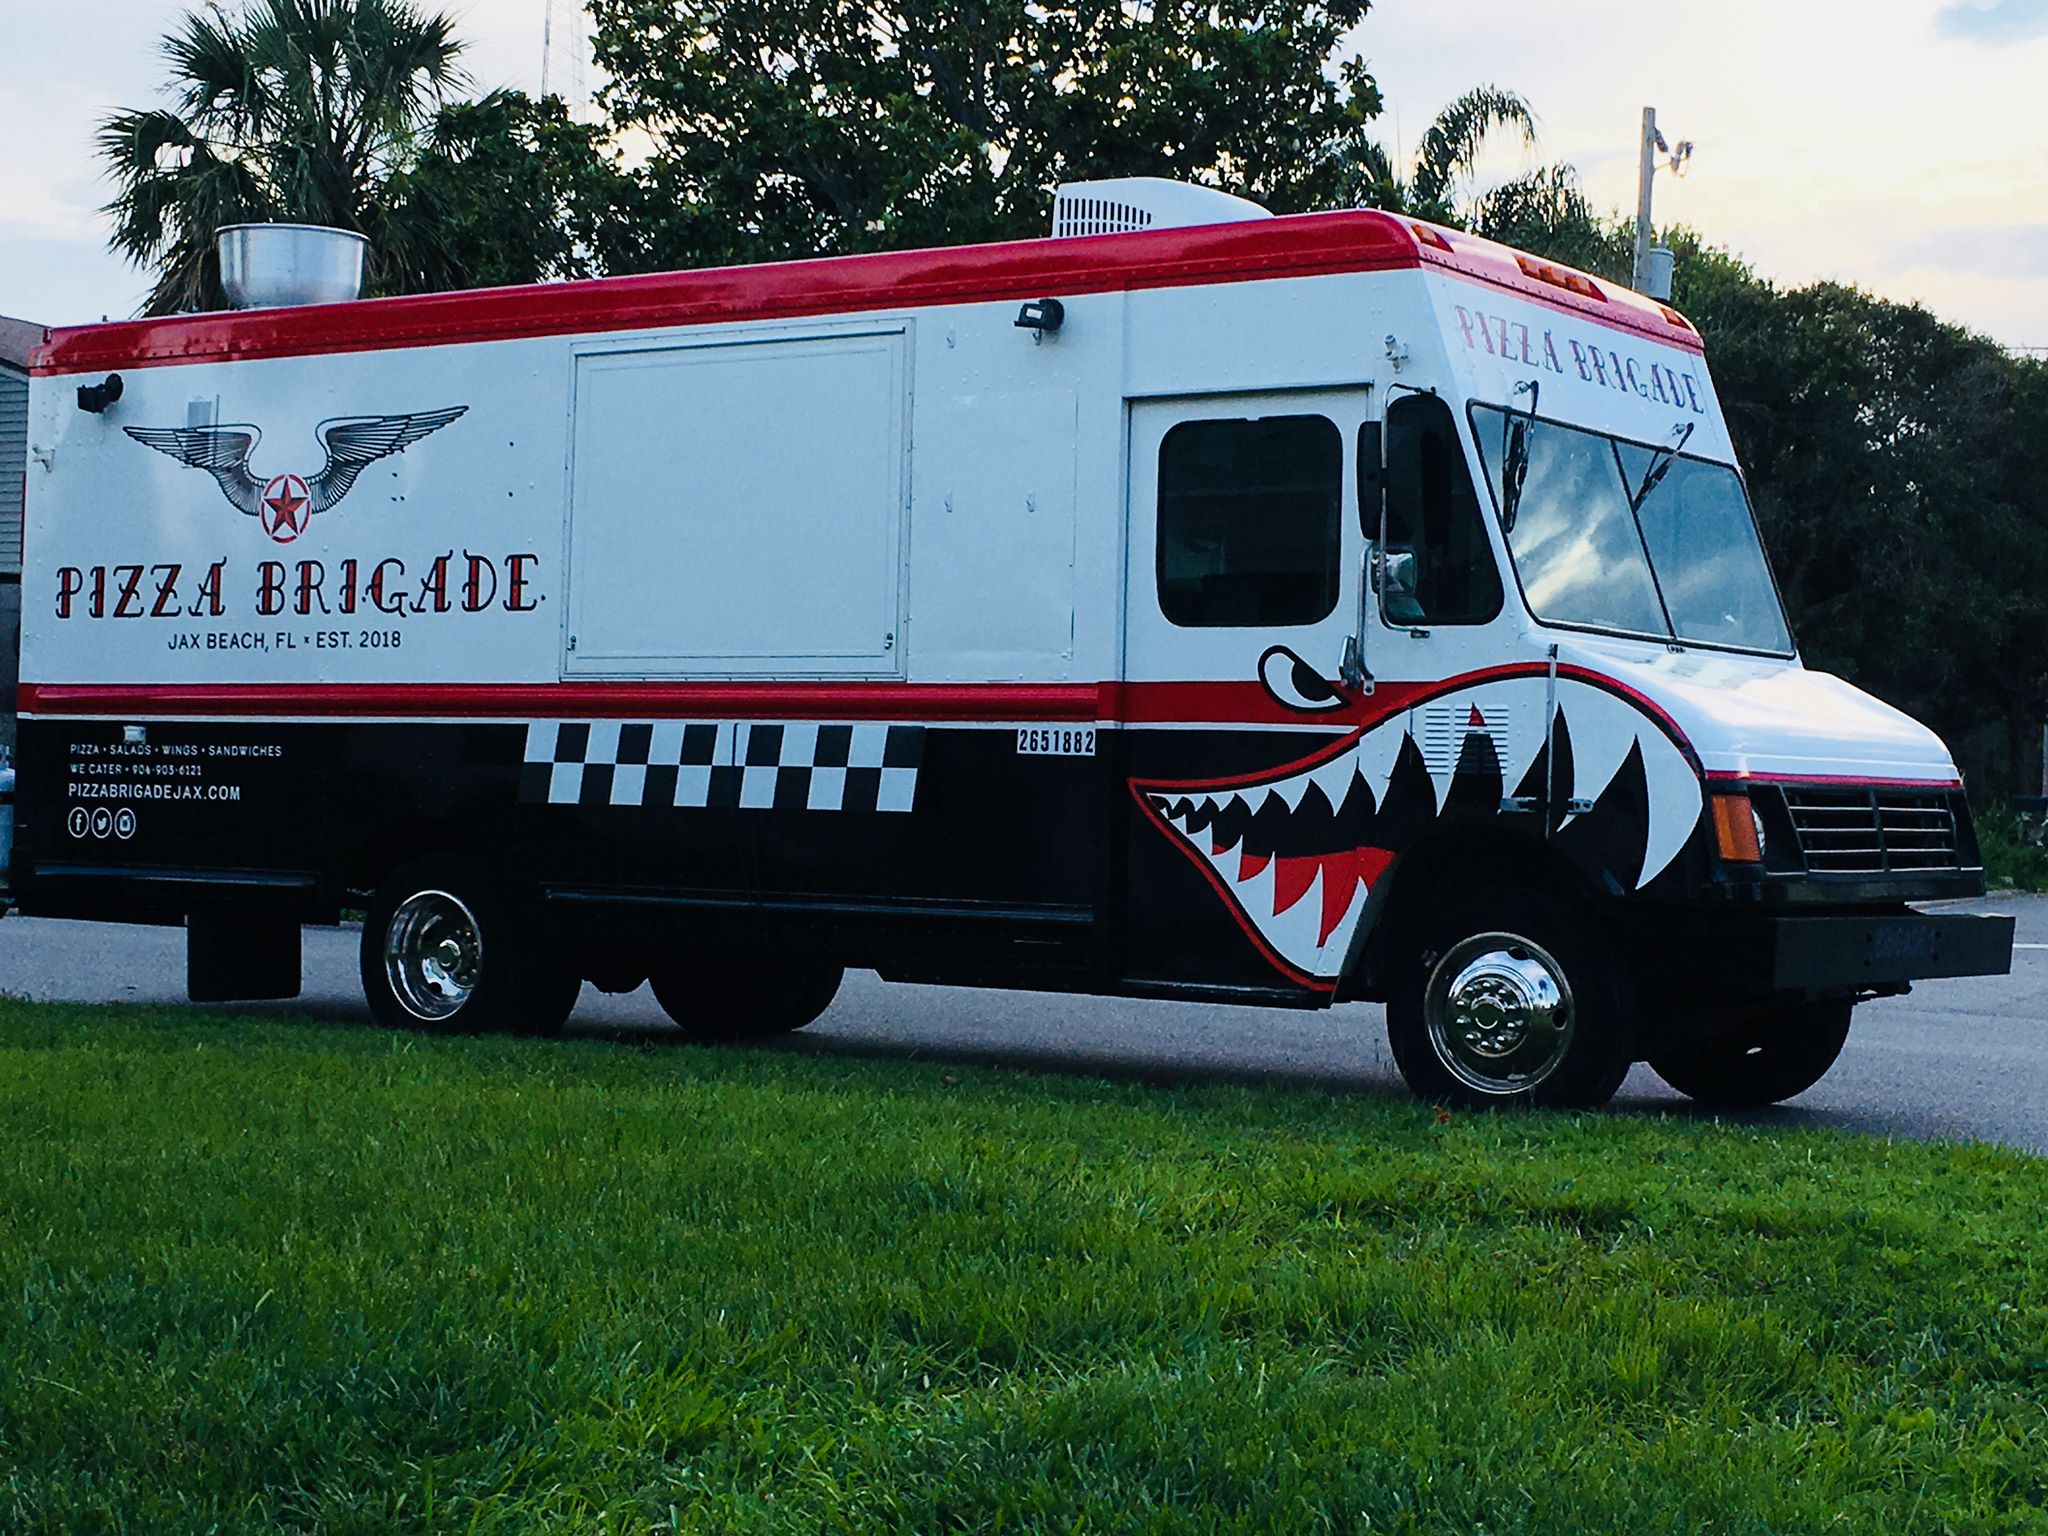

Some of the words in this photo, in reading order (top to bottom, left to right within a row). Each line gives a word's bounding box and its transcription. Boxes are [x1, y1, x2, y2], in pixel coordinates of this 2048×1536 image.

[1454, 305, 1563, 374] PIZZA
[1568, 339, 1704, 414] BRIGADE
[55, 556, 228, 619] PIZZA
[255, 549, 540, 618] BRIGADE
[168, 633, 201, 650] JAX
[206, 633, 269, 653] BEACH,
[276, 632, 296, 649] FL
[316, 632, 353, 649] EST.
[359, 630, 401, 648] 2018
[70, 744, 99, 755] PIZZA
[109, 744, 152, 756] SALADS
[161, 745, 198, 756] WINGS
[208, 745, 283, 757] SANDWICHES
[1019, 729, 1094, 753] 2651882
[70, 763, 86, 774] WE
[89, 764, 122, 775] CATER
[68, 783, 240, 801] PIZZABRIGADEJAX.COM
